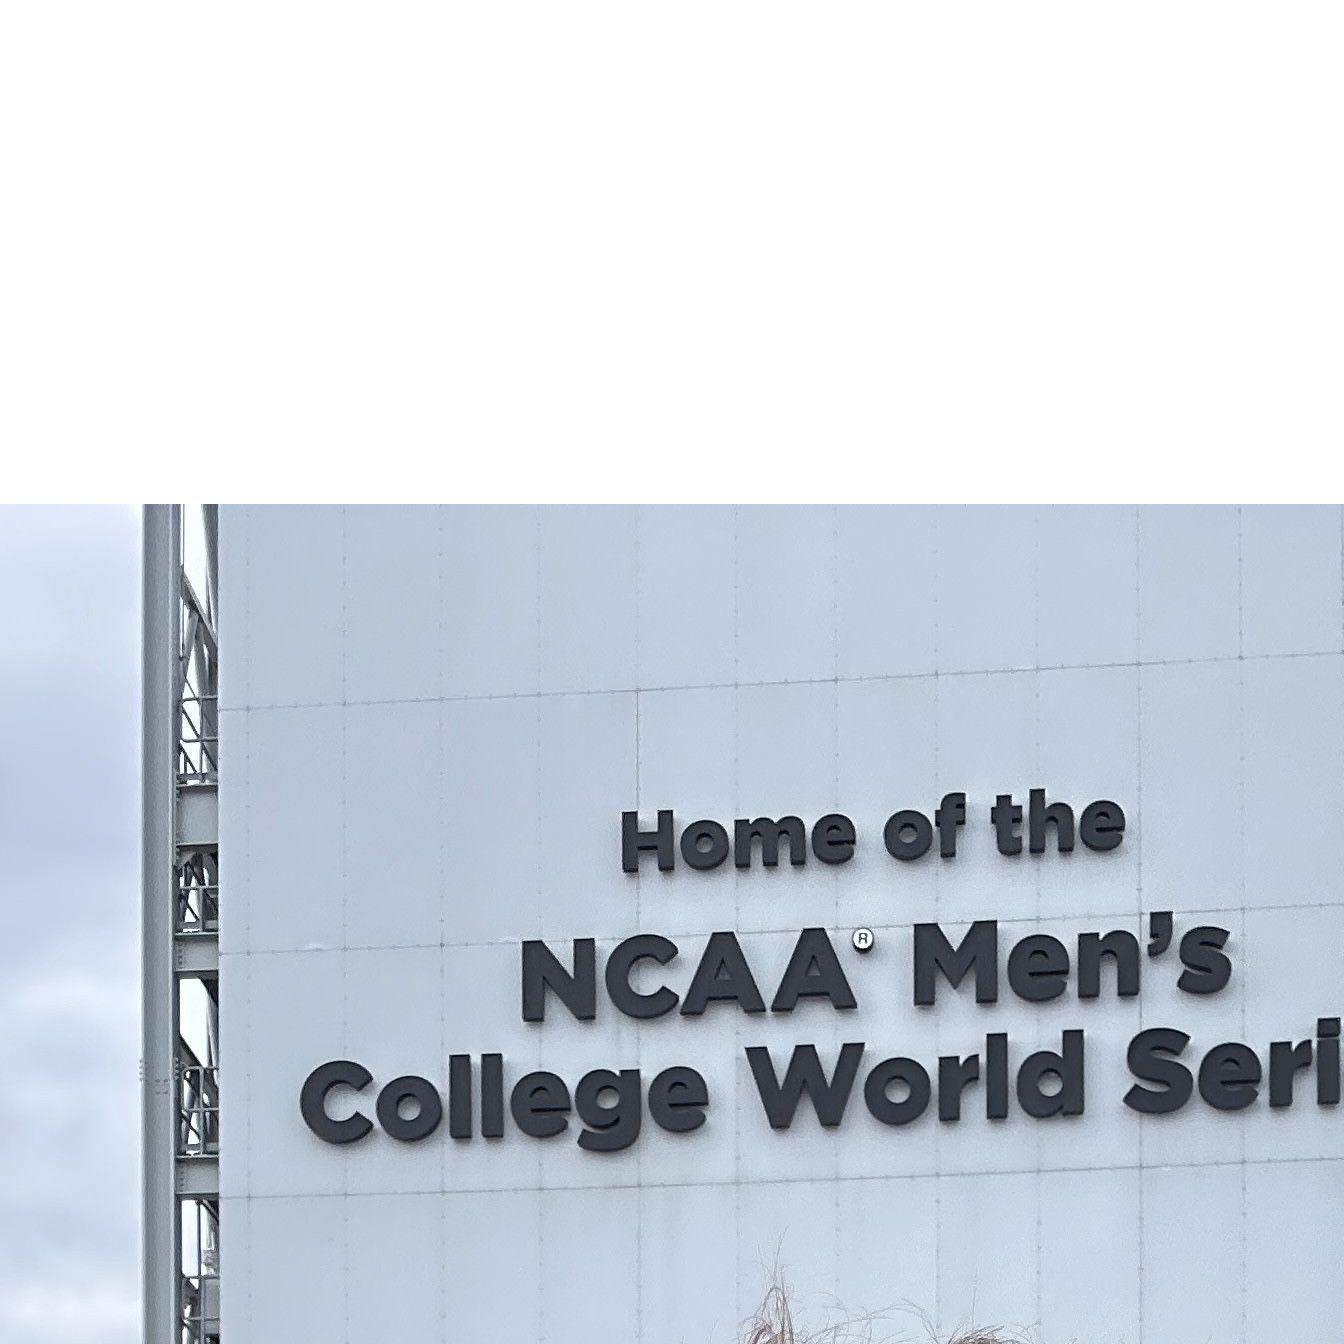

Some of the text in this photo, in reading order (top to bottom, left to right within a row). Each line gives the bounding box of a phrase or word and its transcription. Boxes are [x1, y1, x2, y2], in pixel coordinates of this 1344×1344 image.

[621, 788, 1126, 873] Home of the
[299, 1052, 710, 1153] College
[744, 1029, 1085, 1129] World
